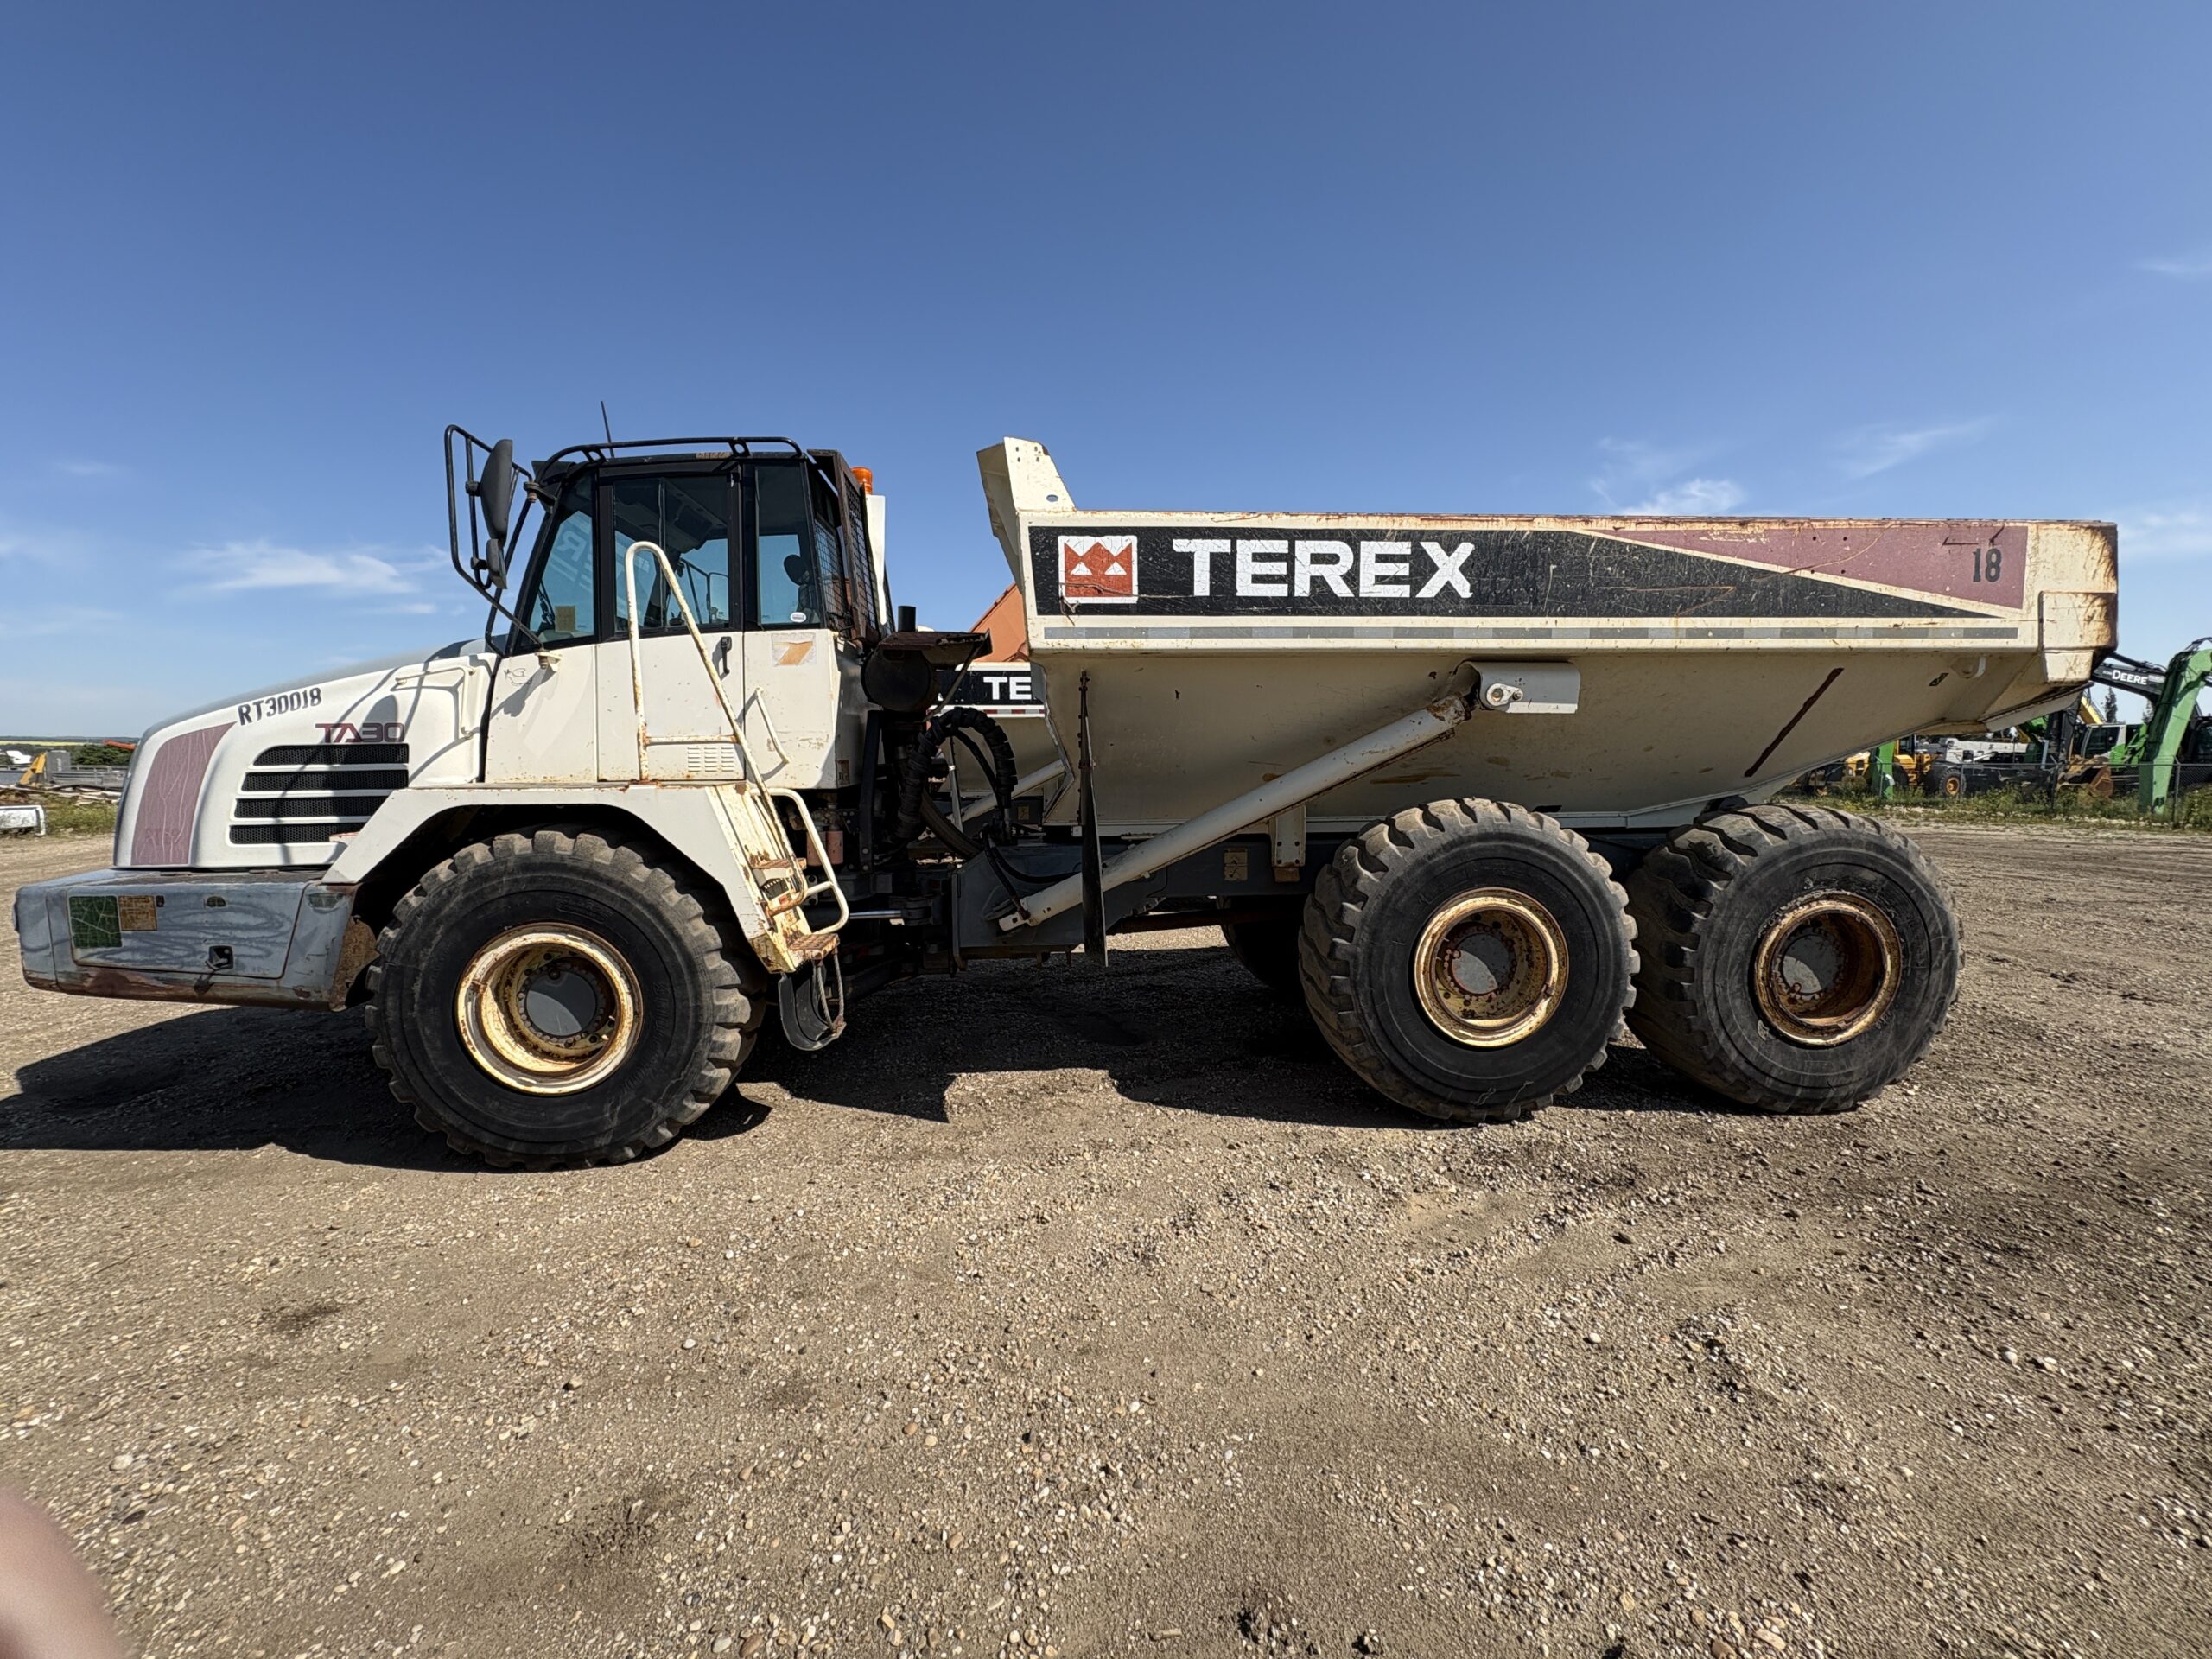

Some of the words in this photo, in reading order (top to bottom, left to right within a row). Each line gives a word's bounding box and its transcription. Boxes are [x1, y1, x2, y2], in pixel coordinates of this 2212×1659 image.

[1173, 538, 1475, 598] TEREX
[1972, 548, 2002, 583] 18
[2112, 669, 2149, 685] DEERE
[238, 687, 322, 726] RT30018
[315, 722, 406, 743] TA30
